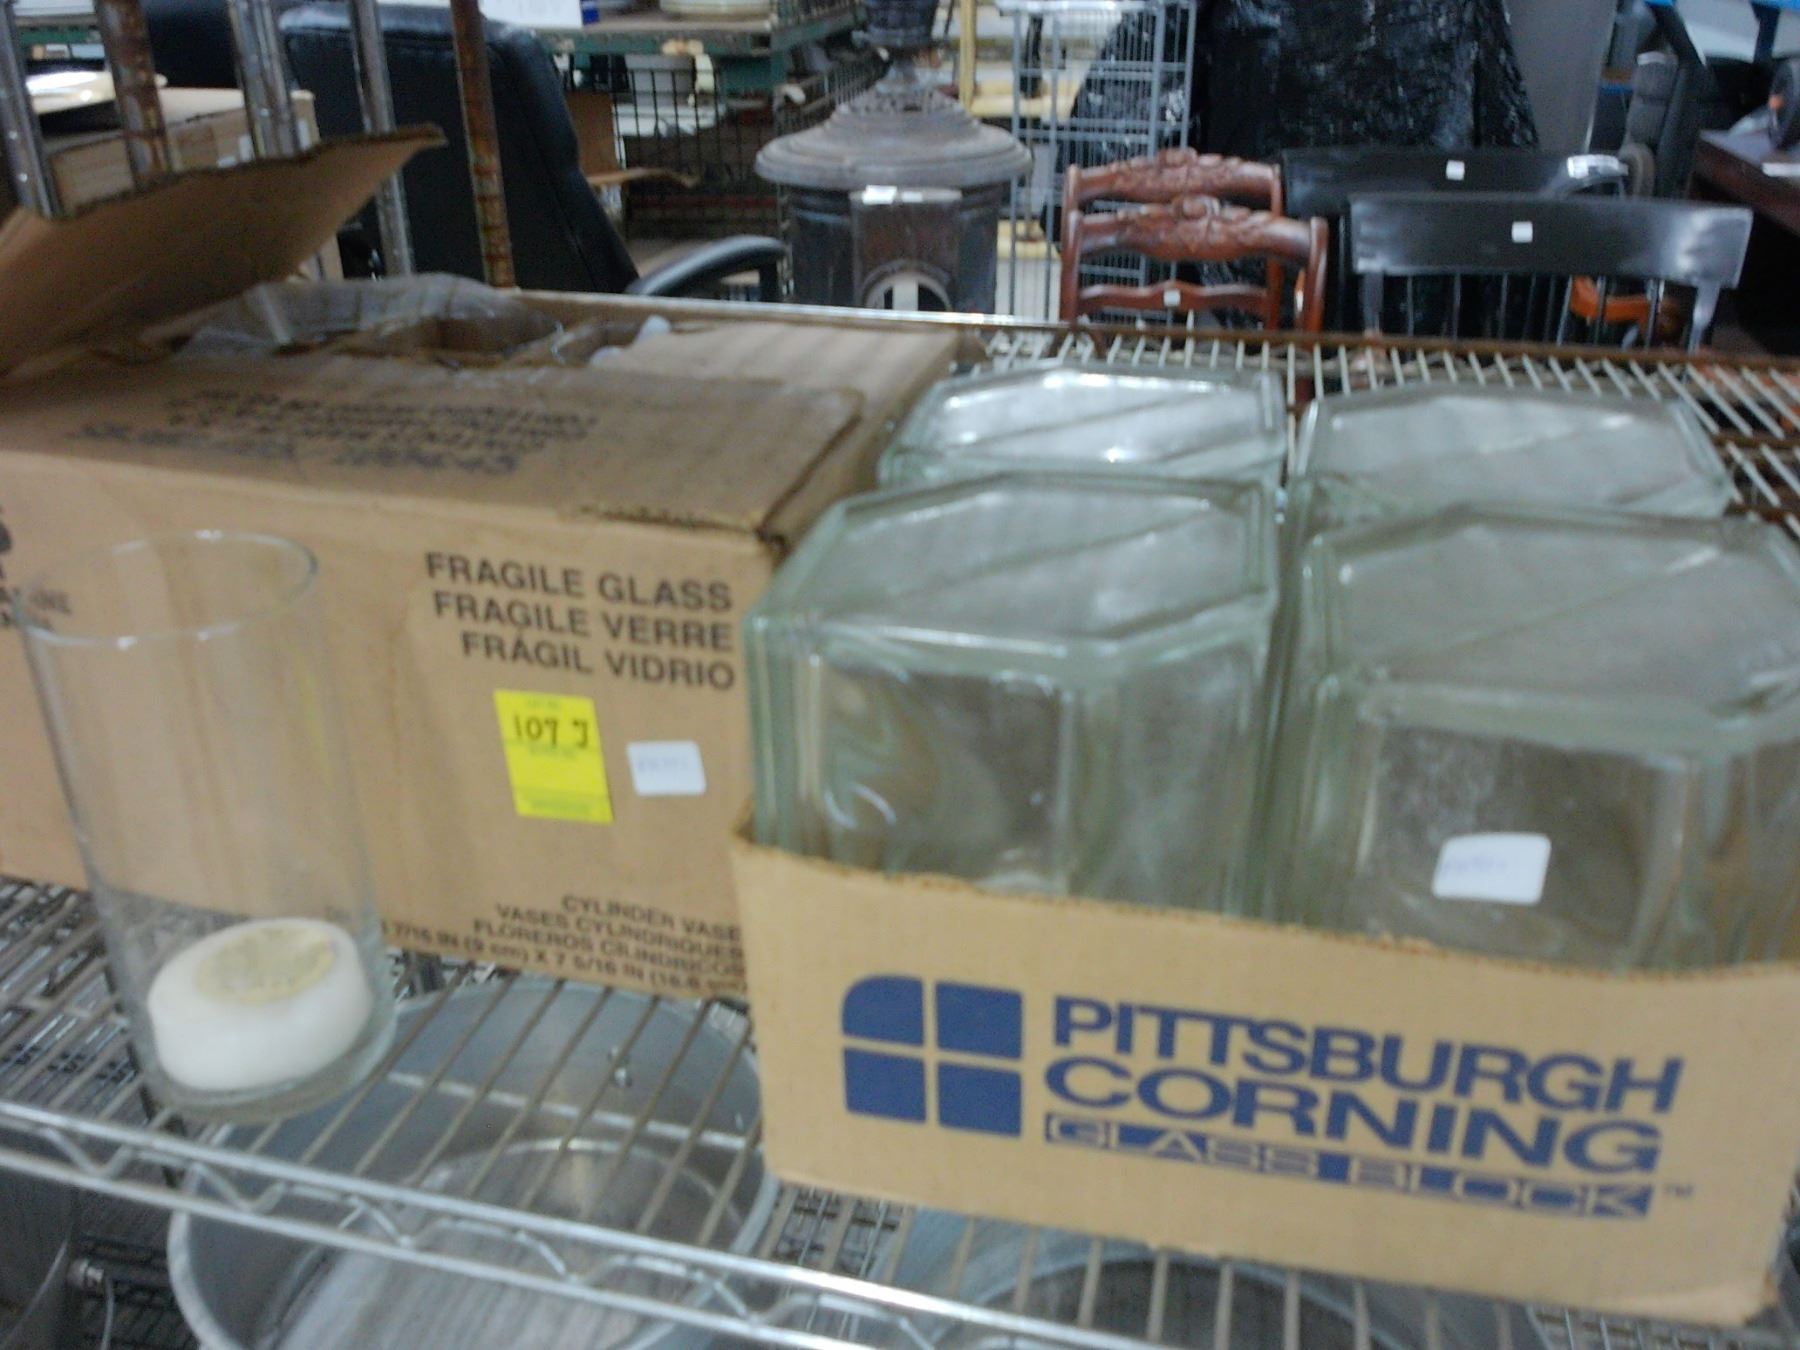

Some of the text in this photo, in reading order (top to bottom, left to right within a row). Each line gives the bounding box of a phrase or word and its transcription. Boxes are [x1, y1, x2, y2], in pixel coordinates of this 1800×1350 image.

[425, 552, 733, 613] FRAGILE GLASS
[433, 590, 736, 651] FRAGILE VERRE
[604, 650, 735, 690] VIDRIO
[561, 894, 674, 929] CYLINDER
[1053, 995, 1683, 1114] PITTSBURGH
[1045, 1055, 1664, 1175] CORNING
